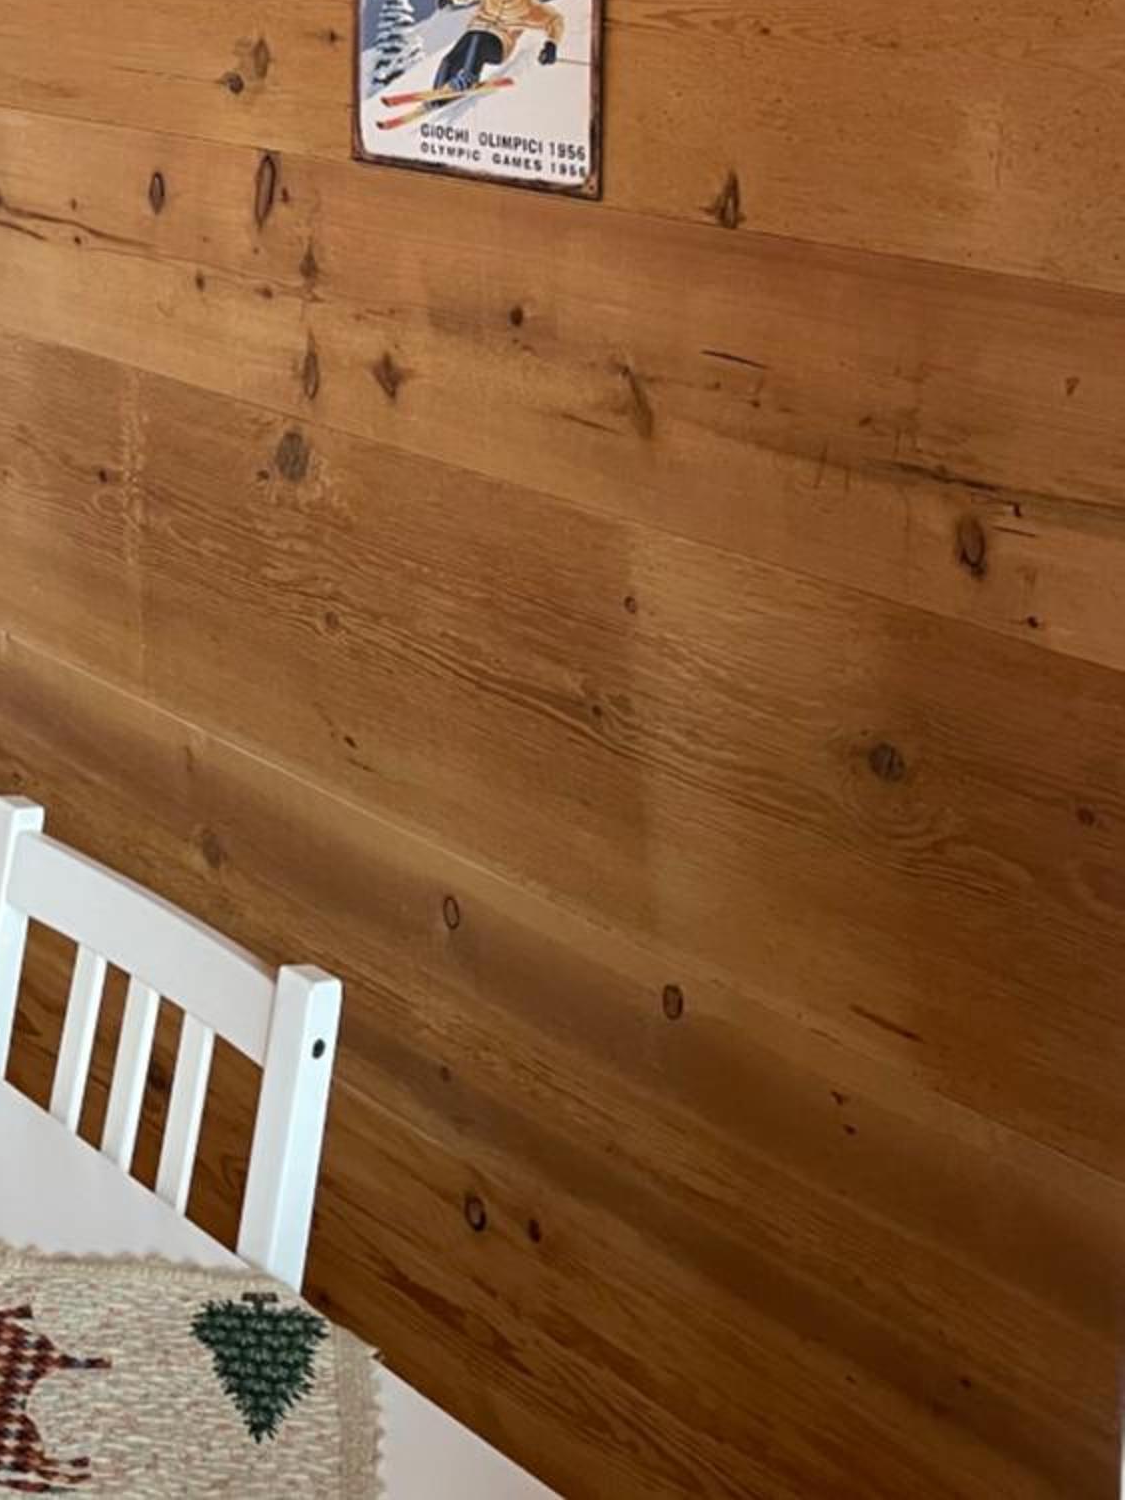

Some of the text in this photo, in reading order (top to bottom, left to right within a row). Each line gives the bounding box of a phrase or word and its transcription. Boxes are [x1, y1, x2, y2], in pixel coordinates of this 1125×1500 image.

[421, 124, 586, 161] GIOCHI OLIMPICI 1956
[421, 142, 586, 177] OLYMPIC GAMES 1956
